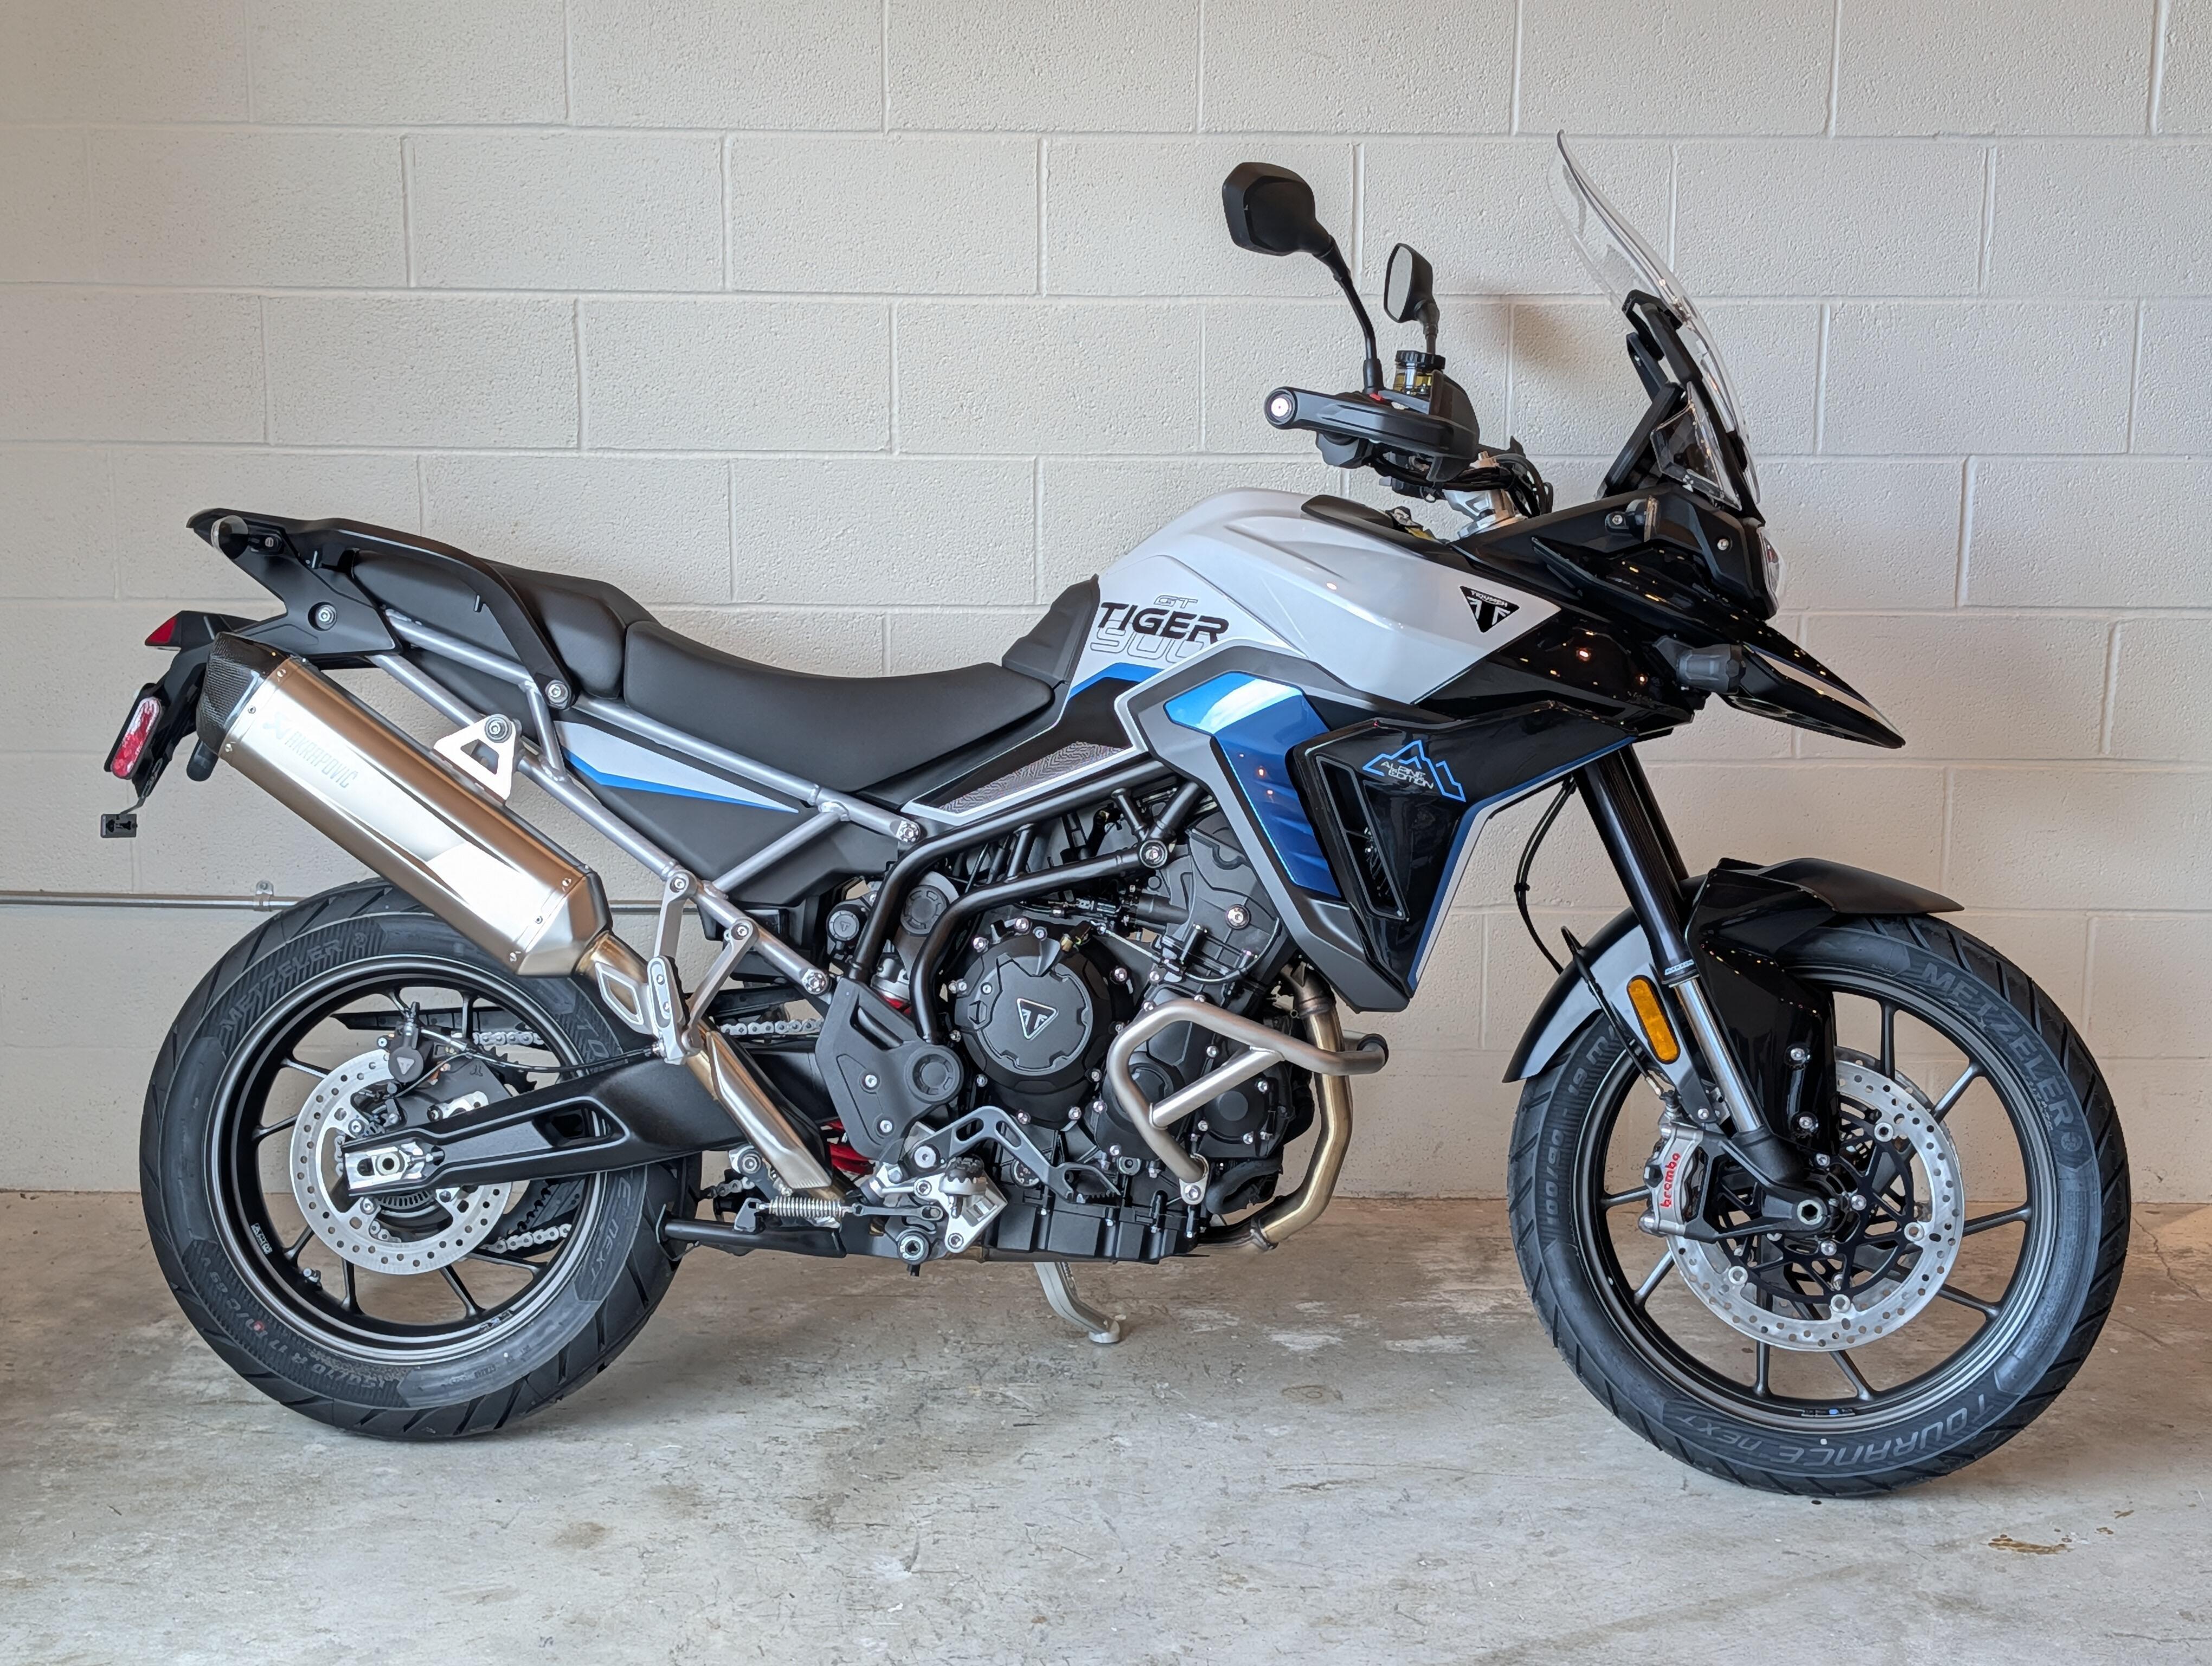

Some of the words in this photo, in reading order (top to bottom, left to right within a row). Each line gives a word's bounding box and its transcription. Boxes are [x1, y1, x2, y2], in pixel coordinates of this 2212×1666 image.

[1098, 602, 1229, 644] TIGER
[1154, 595, 1198, 608] GT
[1388, 768, 1434, 790] EDITION
[219, 939, 343, 1030] METZELER
[1921, 962, 2074, 1127] METZELER
[1567, 1067, 1589, 1097] 19
[1660, 1153, 1681, 1207] brembo
[1770, 1393, 1995, 1467] TOURANCE
